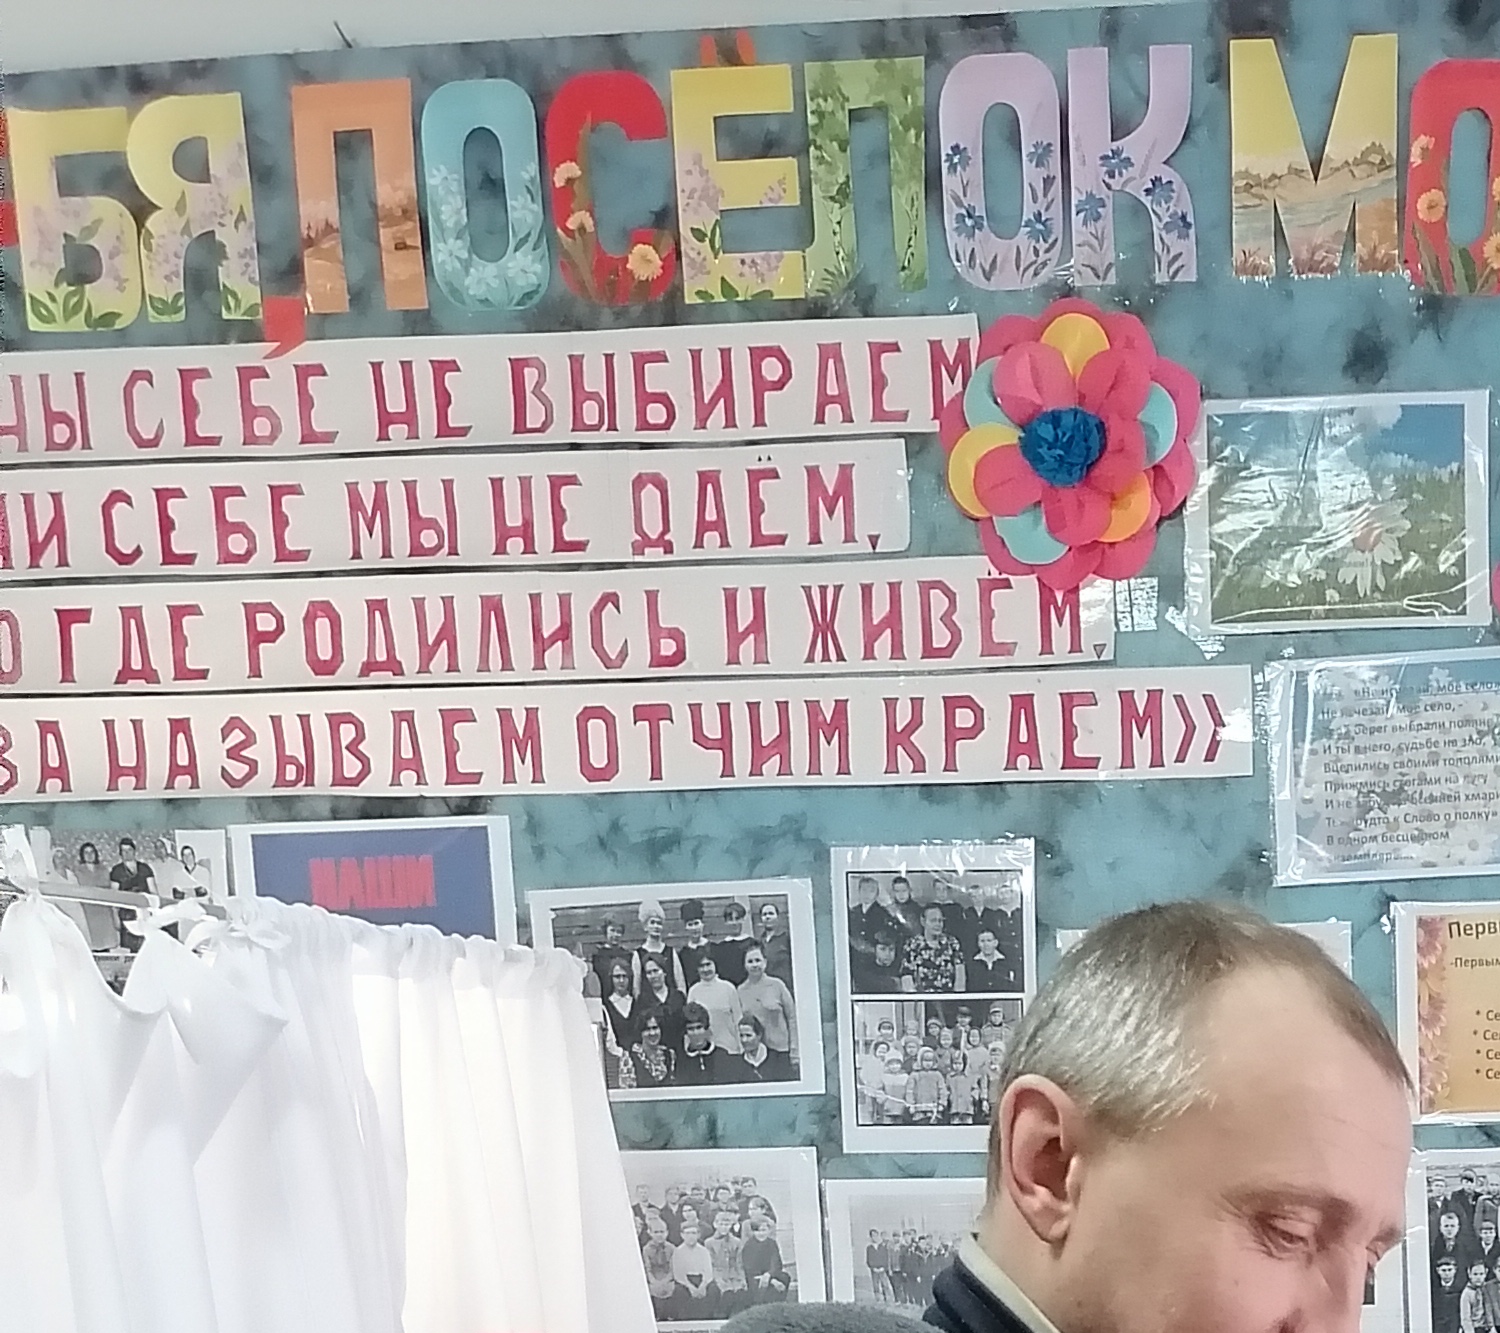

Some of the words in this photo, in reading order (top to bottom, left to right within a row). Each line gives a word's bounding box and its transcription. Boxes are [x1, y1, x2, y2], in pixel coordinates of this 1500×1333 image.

[291, 28, 1198, 314] ПОСЁЛОК
[122, 363, 340, 449] СЕБЕ
[367, 358, 474, 443] НЕ
[507, 338, 976, 436] ВЫБИРАЕМ
[100, 483, 313, 567] СЕБЕ
[344, 478, 461, 560] МЫ
[488, 473, 591, 556] НЕ
[54, 602, 211, 686] ГДЕ
[241, 588, 687, 679] РОДИЛИСЬ
[721, 586, 771, 666] И
[1423, 701, 1457, 714] село,
[1391, 718, 1447, 734] выбрали
[101, 706, 546, 792] НАЗЫВАЕМ
[575, 699, 852, 784] ОТЧИМ
[1322, 743, 1332, 755] И
[1335, 742, 1351, 754] ты
[1323, 760, 1390, 775] Вцепились
[1392, 758, 1440, 770] своими
[1324, 778, 1390, 793] Прижмись
[1444, 774, 1460, 784] на
[1325, 798, 1334, 809] И
[1337, 798, 1353, 809] не
[1402, 810, 1441, 824] Слово
[1454, 808, 1499, 824] полку»
[1326, 834, 1335, 846] В
[1337, 832, 1379, 848] одном
